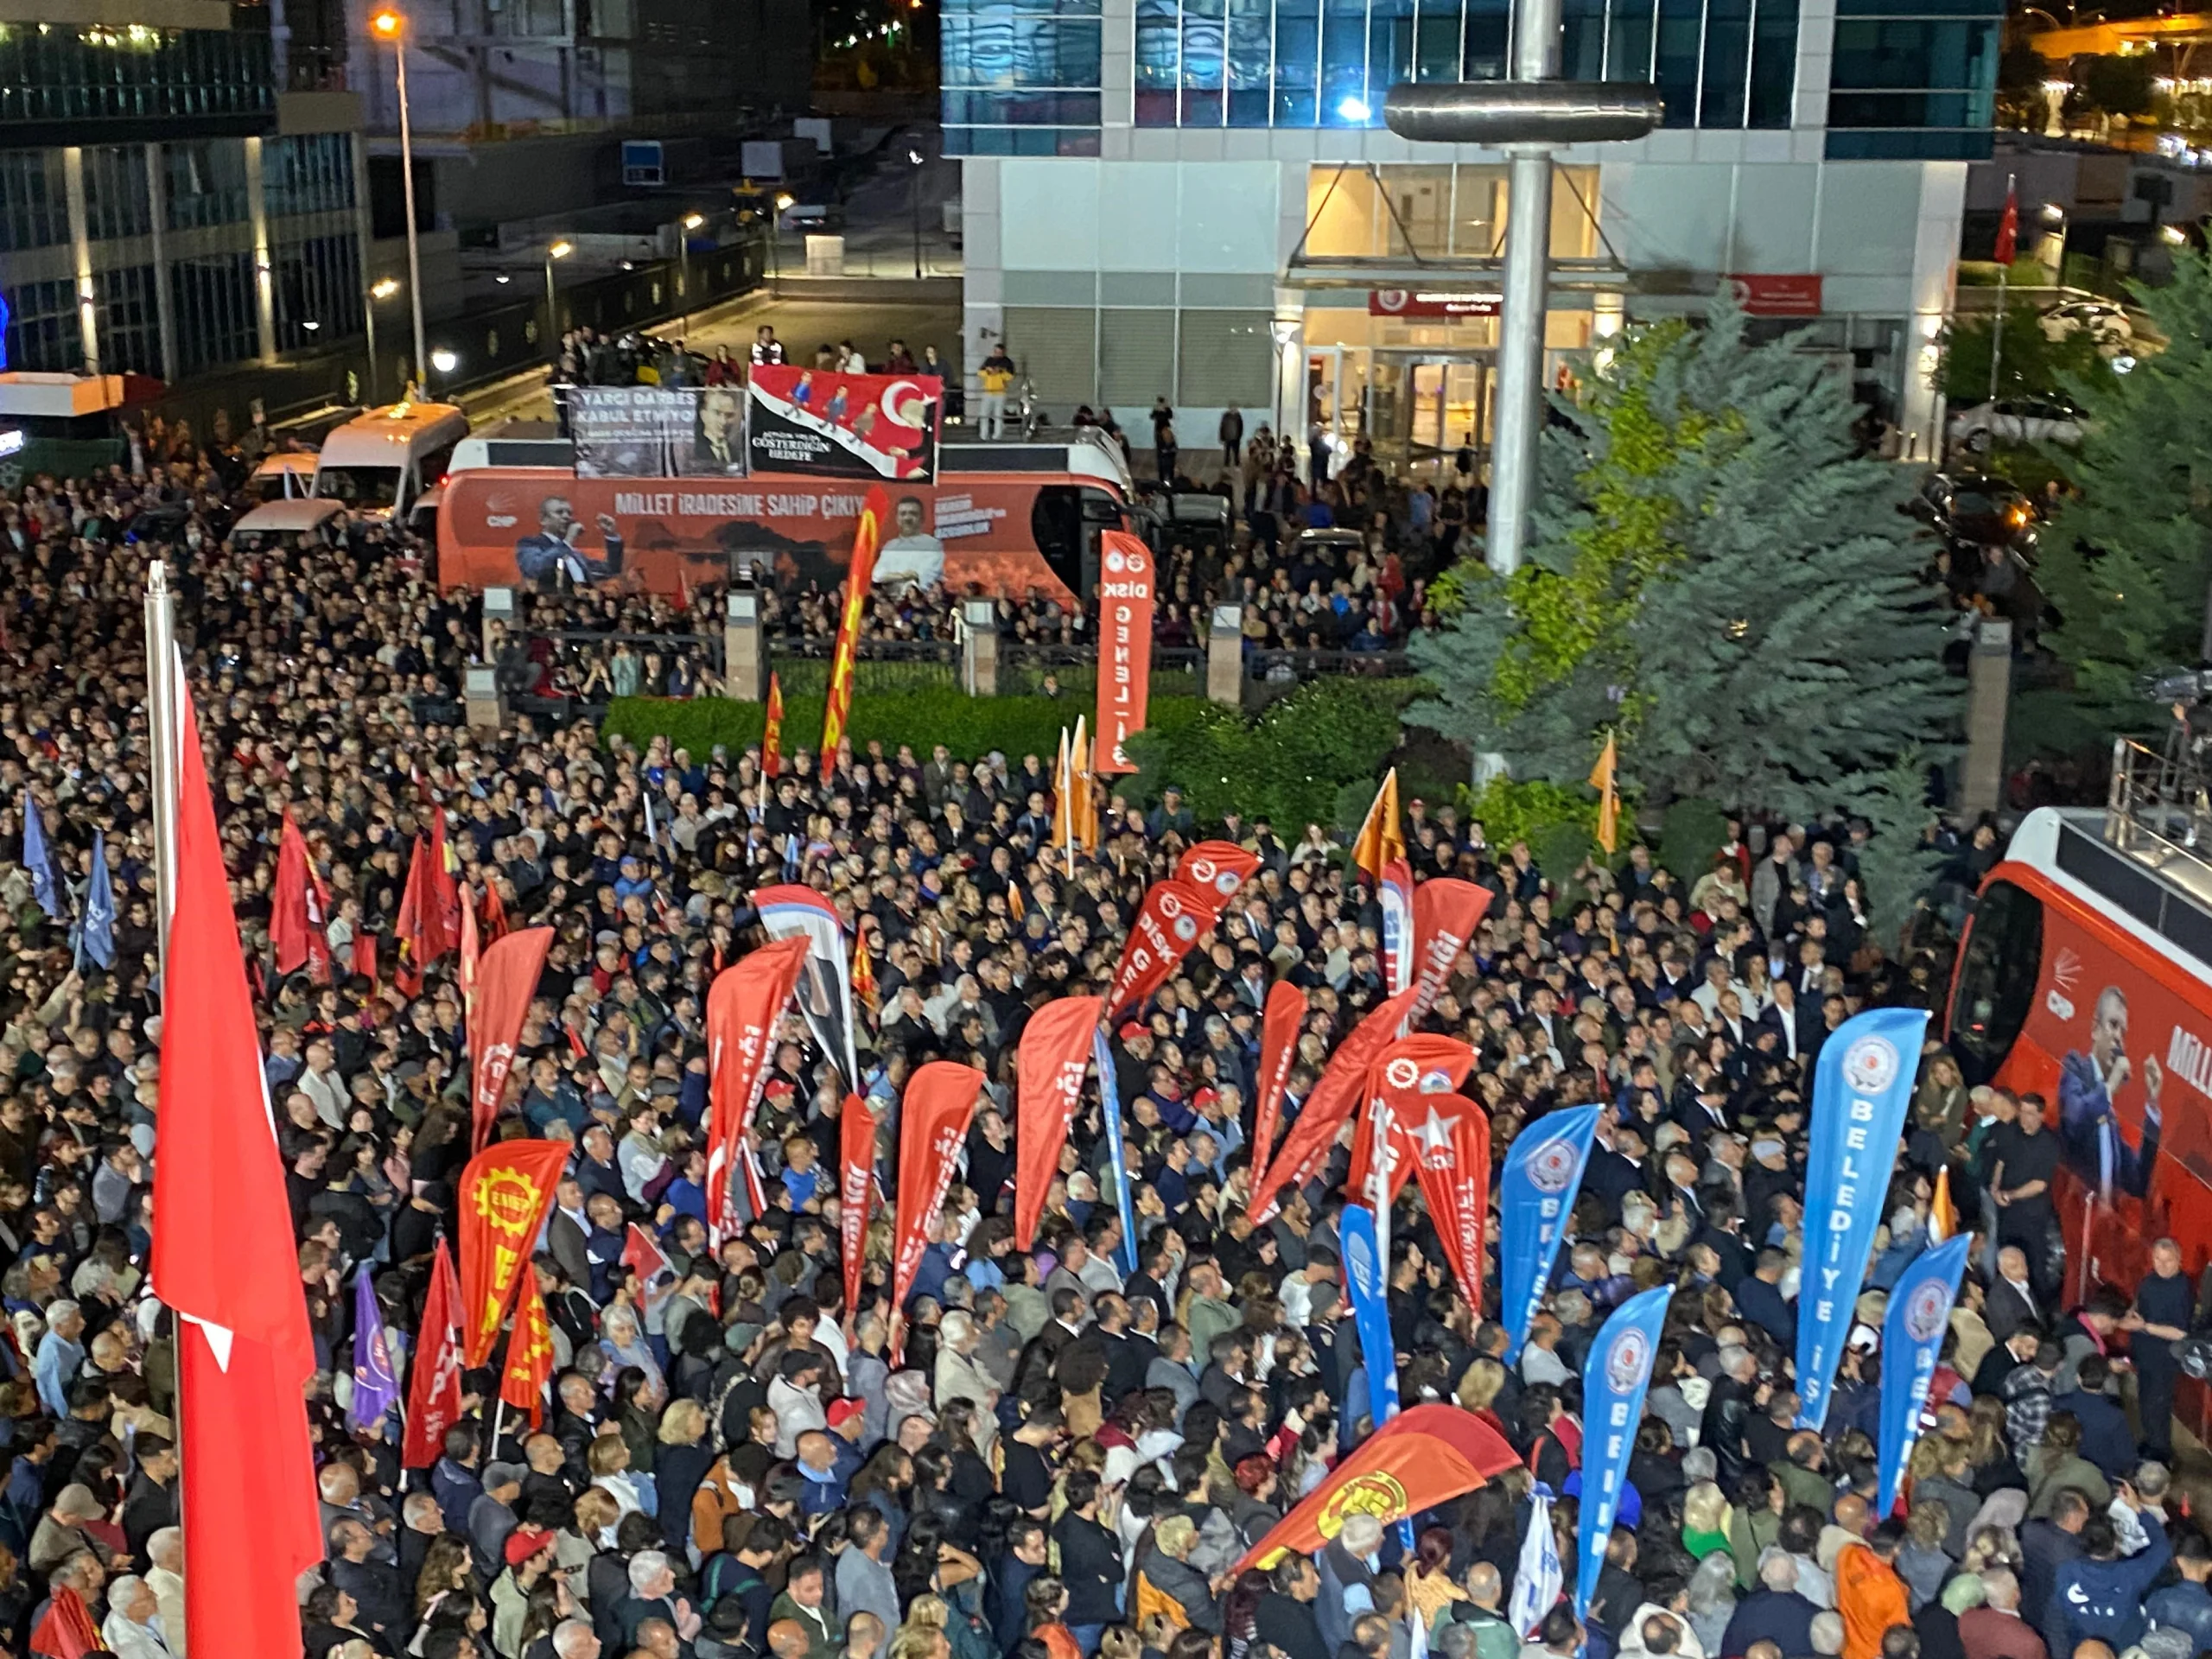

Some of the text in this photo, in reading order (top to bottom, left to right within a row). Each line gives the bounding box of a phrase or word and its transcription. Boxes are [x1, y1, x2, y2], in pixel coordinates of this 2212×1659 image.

[576, 410, 630, 423] KABUL
[614, 493, 674, 516] MİLLET
[678, 493, 765, 516] İRADESİNE
[766, 493, 817, 517] SAHİP
[1139, 911, 1179, 965] DİSK
[1815, 1099, 1873, 1323] BELEDİYE
